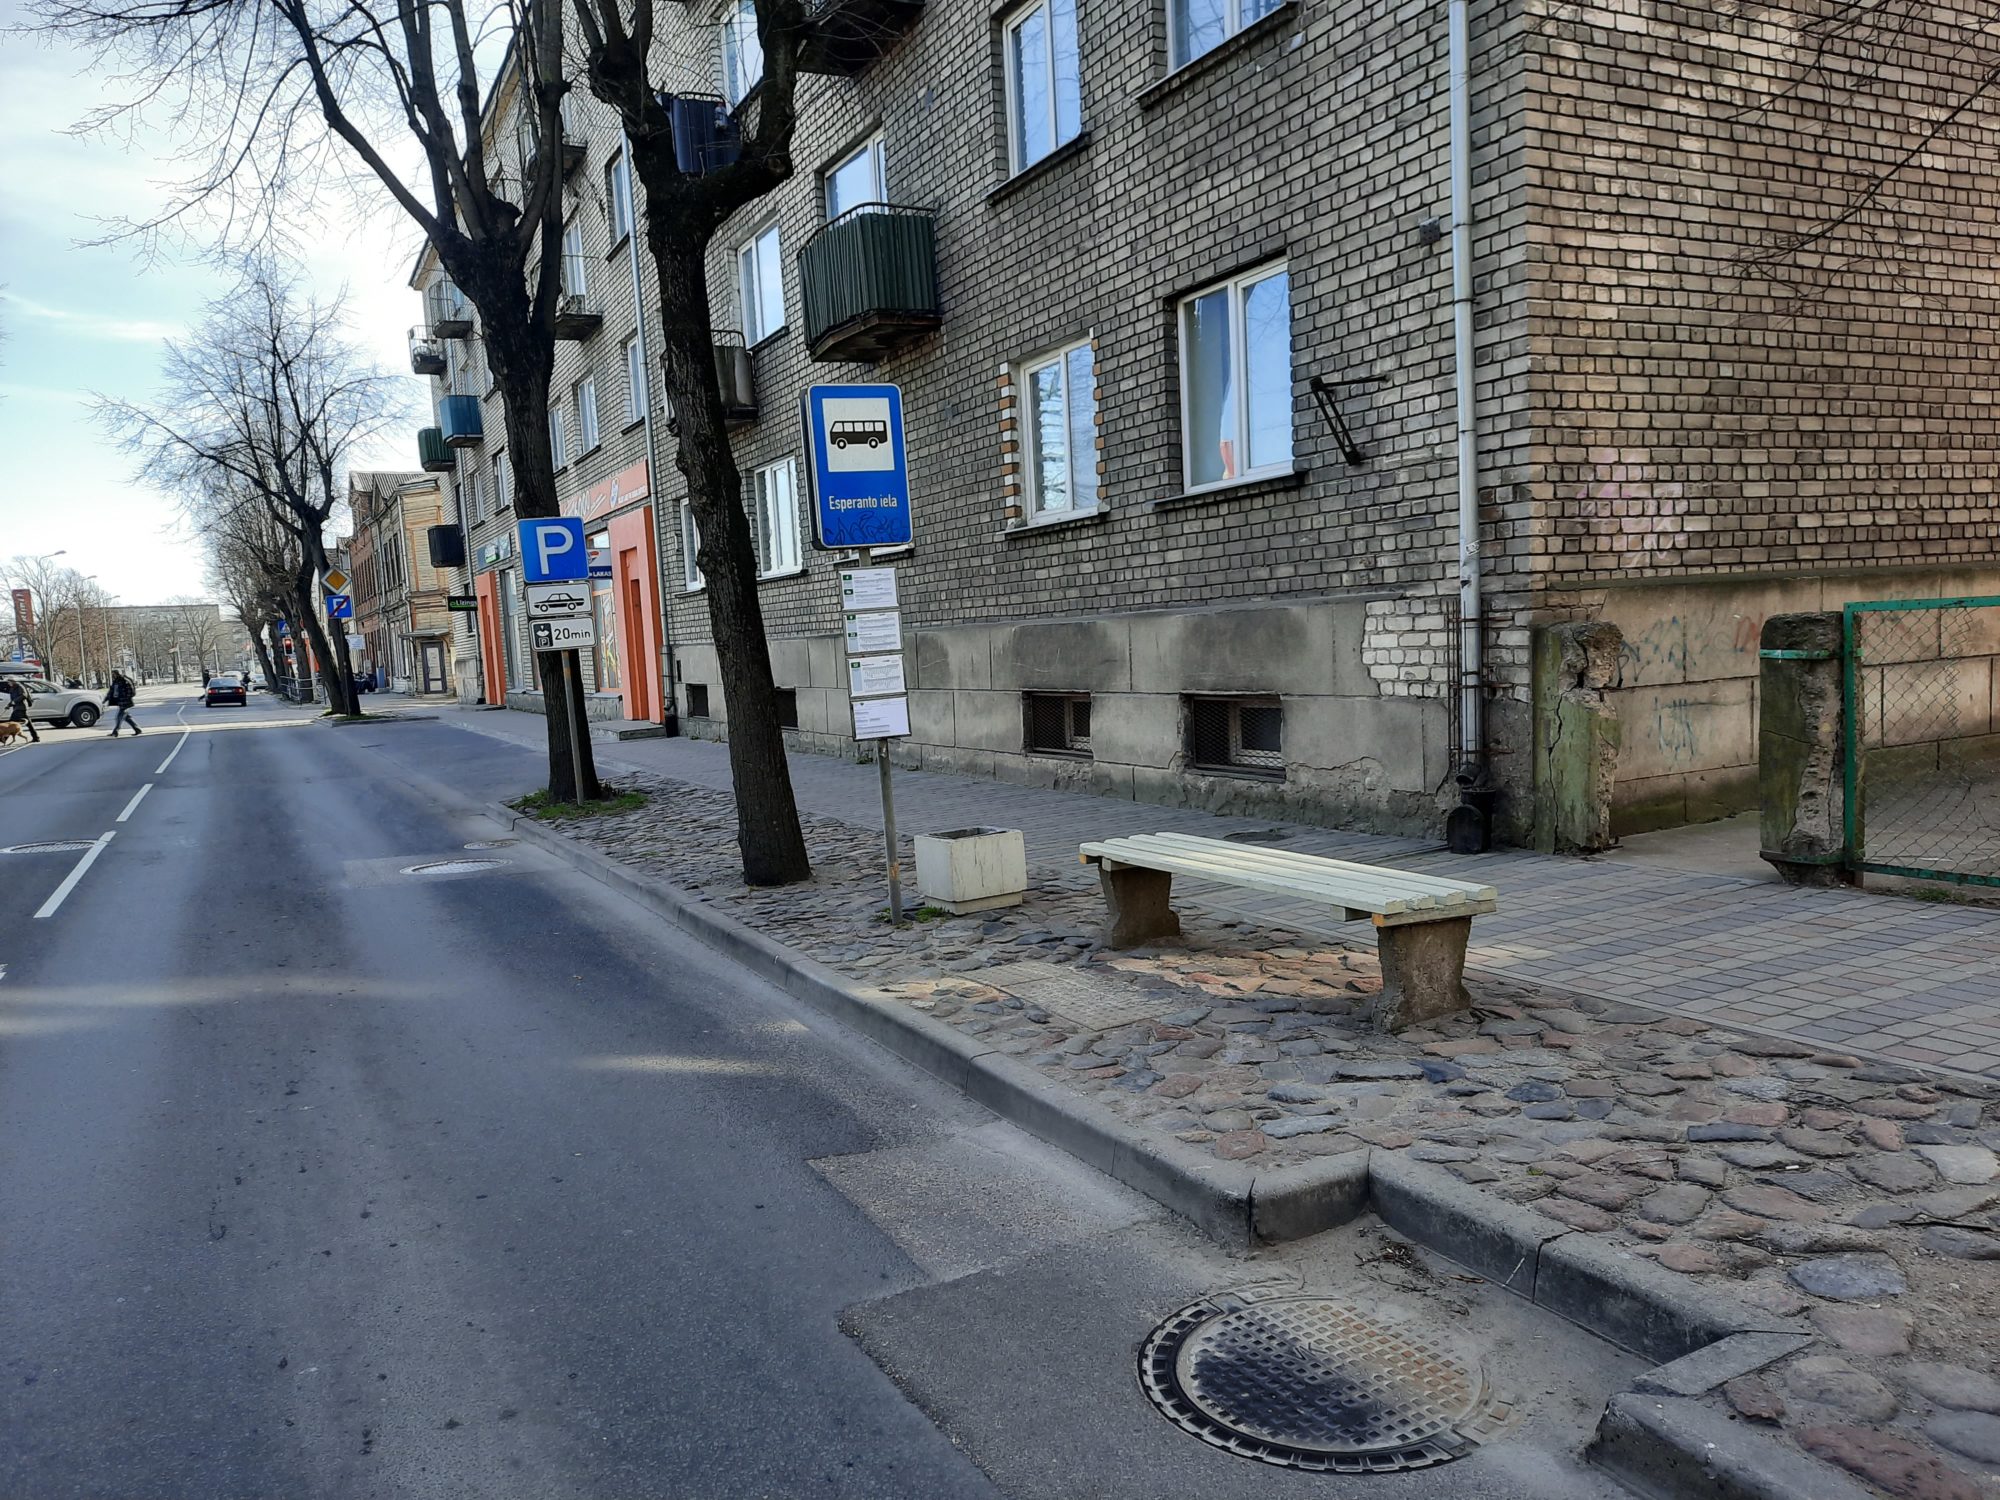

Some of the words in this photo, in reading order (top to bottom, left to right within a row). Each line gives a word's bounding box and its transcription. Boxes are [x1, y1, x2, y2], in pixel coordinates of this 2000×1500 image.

[828, 495, 878, 513] Esperanto
[879, 493, 898, 508] iela
[535, 525, 574, 575] P
